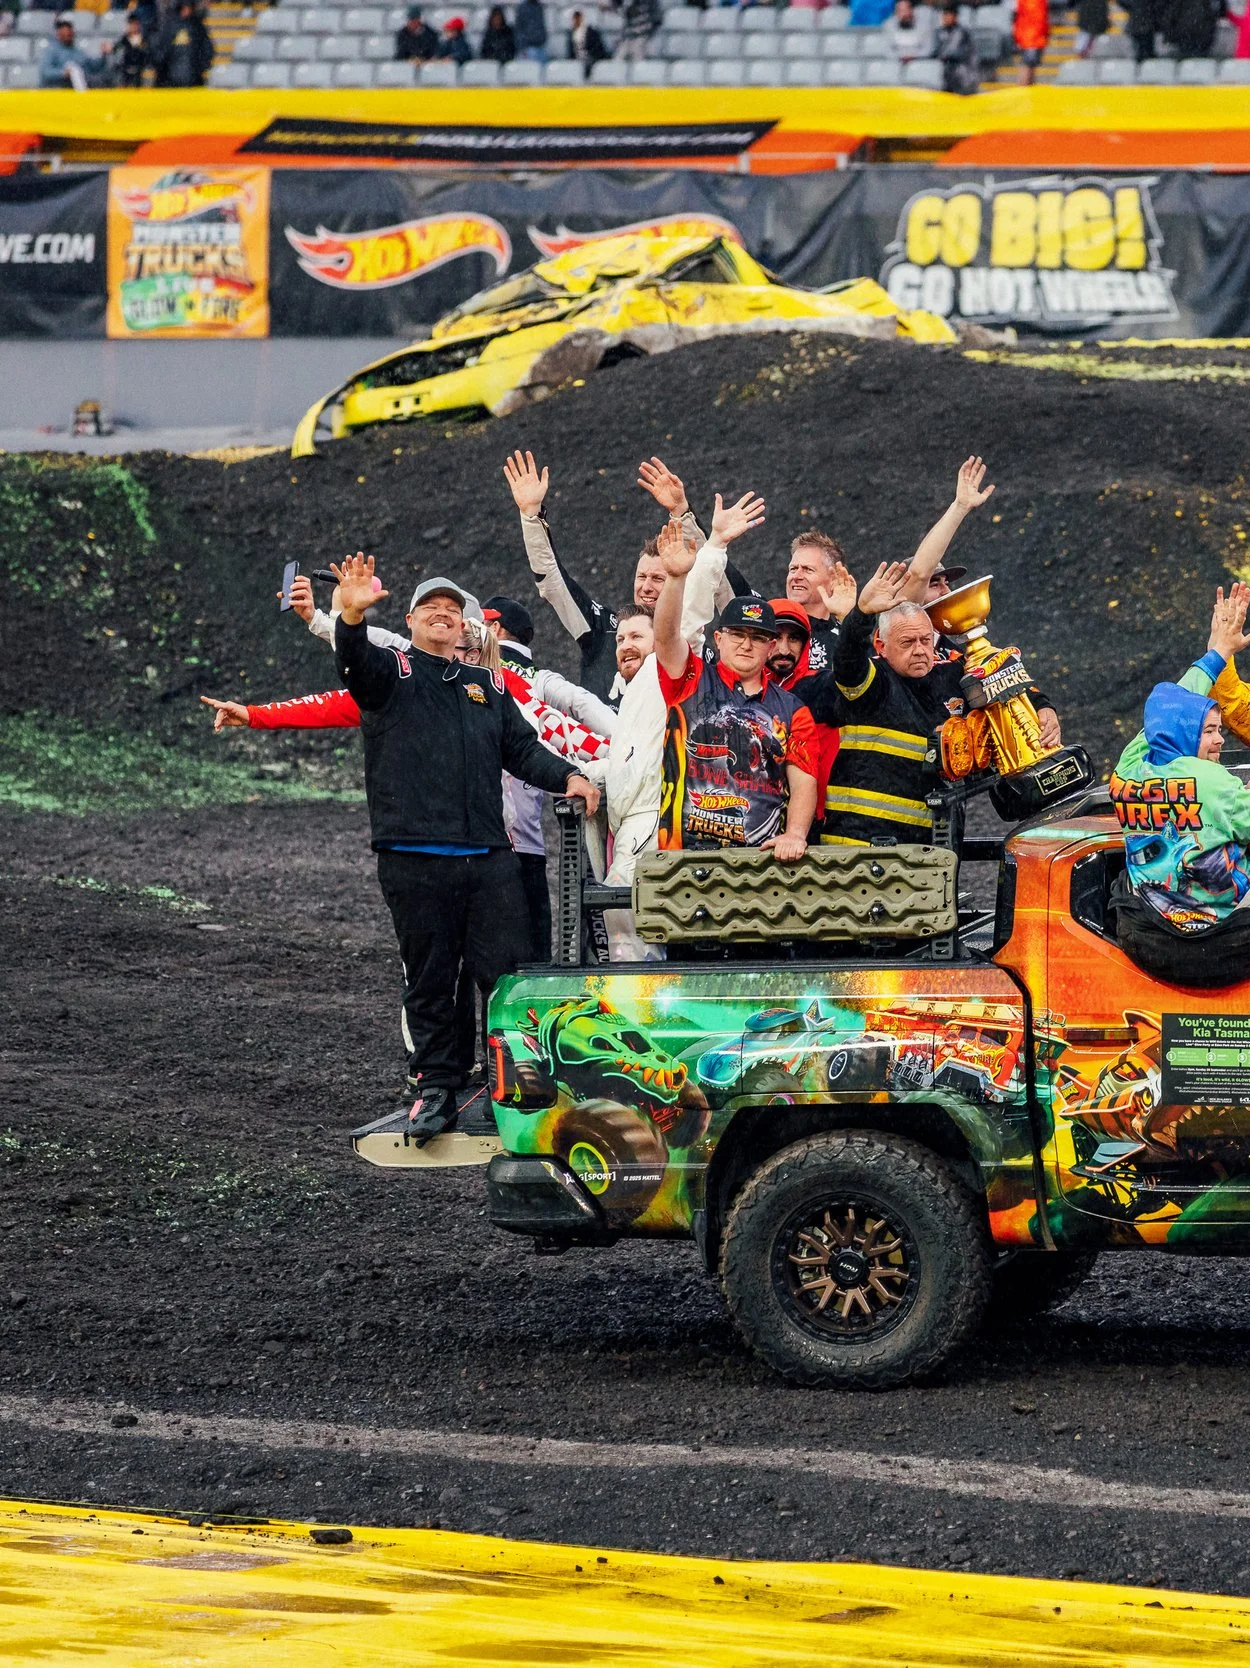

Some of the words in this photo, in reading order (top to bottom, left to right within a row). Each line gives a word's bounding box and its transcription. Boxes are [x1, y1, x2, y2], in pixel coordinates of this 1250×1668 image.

[905, 194, 982, 267] GO
[990, 187, 1147, 270] BIG!
[888, 262, 955, 316] GO
[982, 668, 1034, 704] TRUCKS
[687, 758, 729, 788] BONE
[687, 815, 746, 842] TRUCKS
[1178, 1017, 1216, 1028] You've
[1218, 1018, 1250, 1028] found
[1193, 1028, 1211, 1038] Kia
